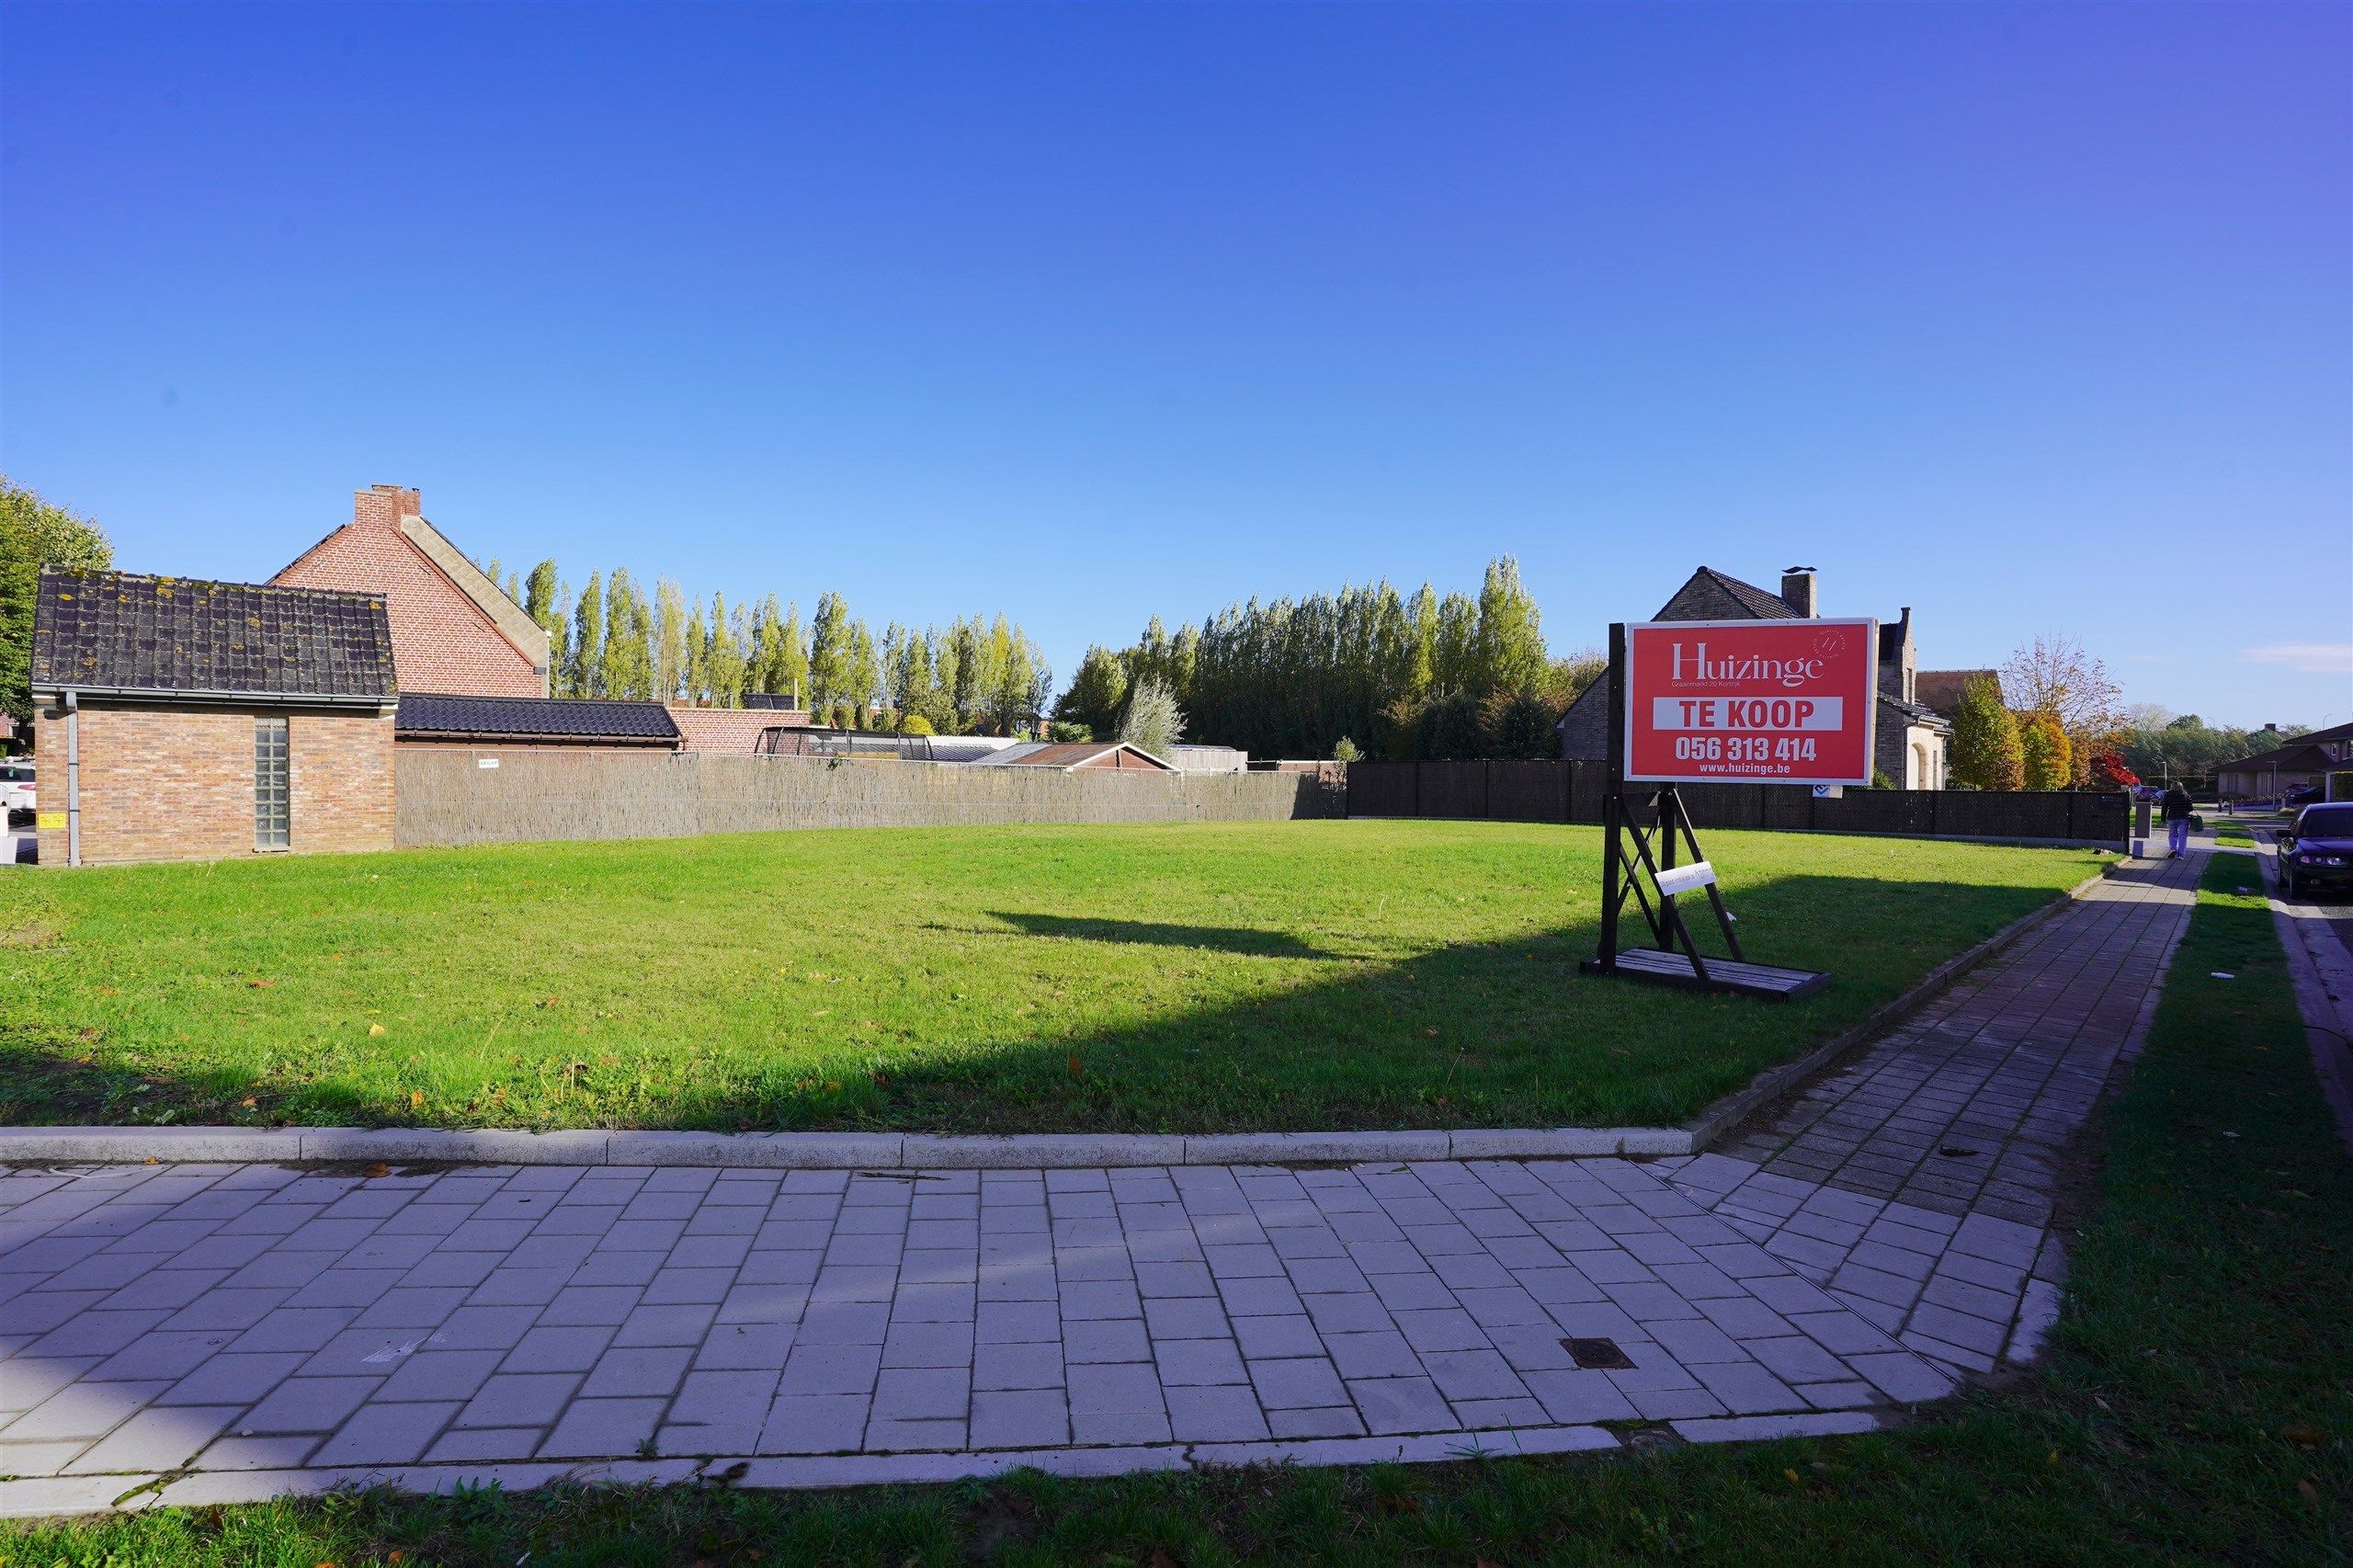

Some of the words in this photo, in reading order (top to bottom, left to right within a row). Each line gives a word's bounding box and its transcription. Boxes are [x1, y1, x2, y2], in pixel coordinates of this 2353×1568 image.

[1671, 642, 1824, 687] Huizinge
[1718, 679, 1741, 688] Kortrijk
[1679, 700, 1715, 728] TE
[1728, 699, 1814, 729] KOOP
[1676, 736, 1722, 760] 056
[1727, 737, 1769, 761] 313
[1774, 738, 1817, 762] 414
[1699, 763, 1790, 775] www.huizinge.be
